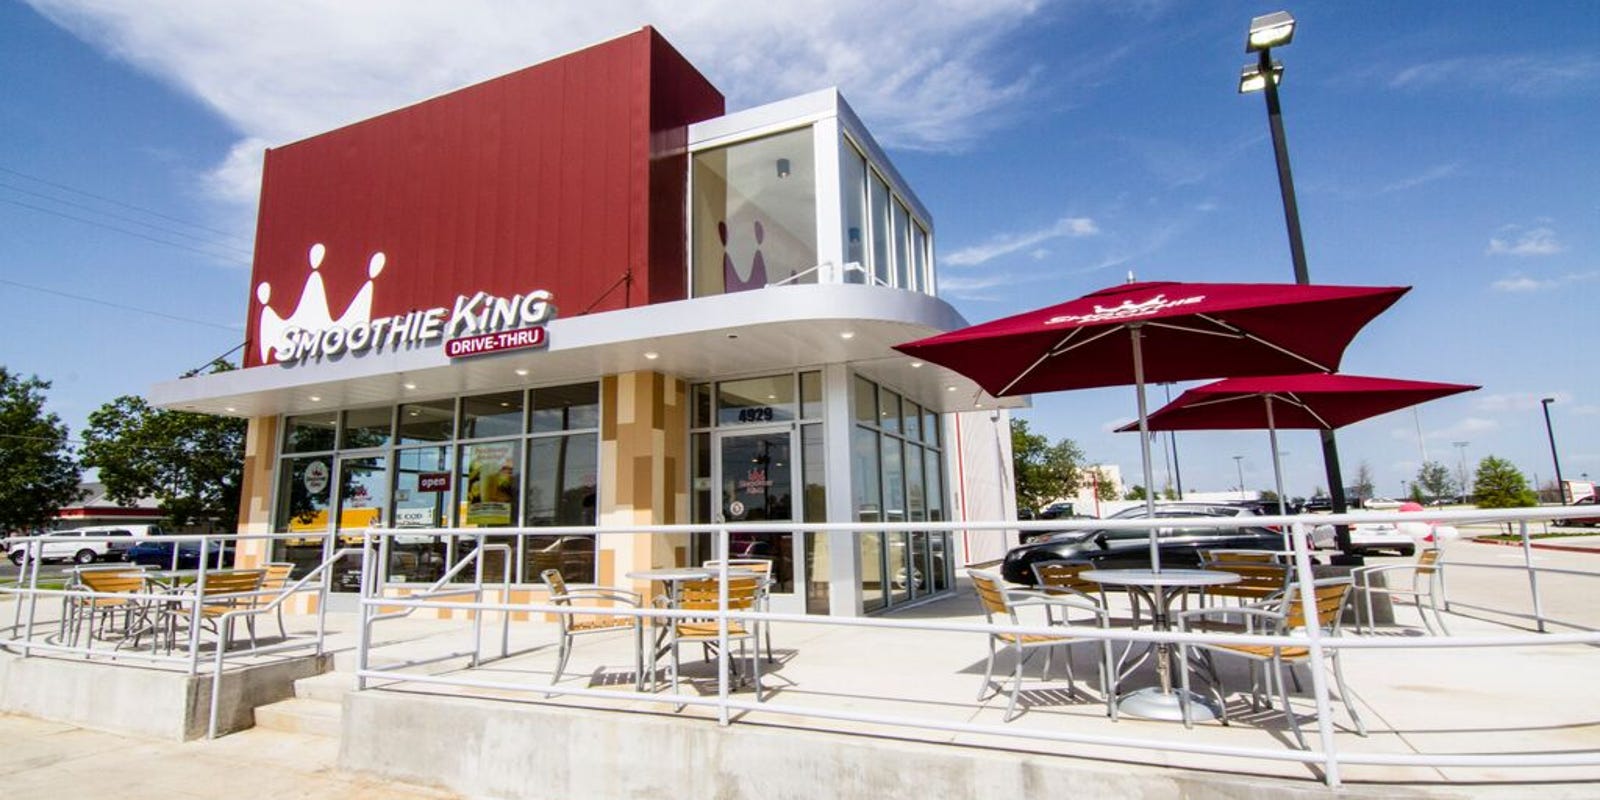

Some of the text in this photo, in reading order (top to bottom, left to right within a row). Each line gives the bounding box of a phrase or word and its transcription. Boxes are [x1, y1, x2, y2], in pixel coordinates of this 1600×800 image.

[274, 307, 448, 363] SMOOTHIE
[451, 329, 540, 355] DRIVE-THRU
[739, 407, 773, 423] 4929
[421, 478, 446, 489] open
